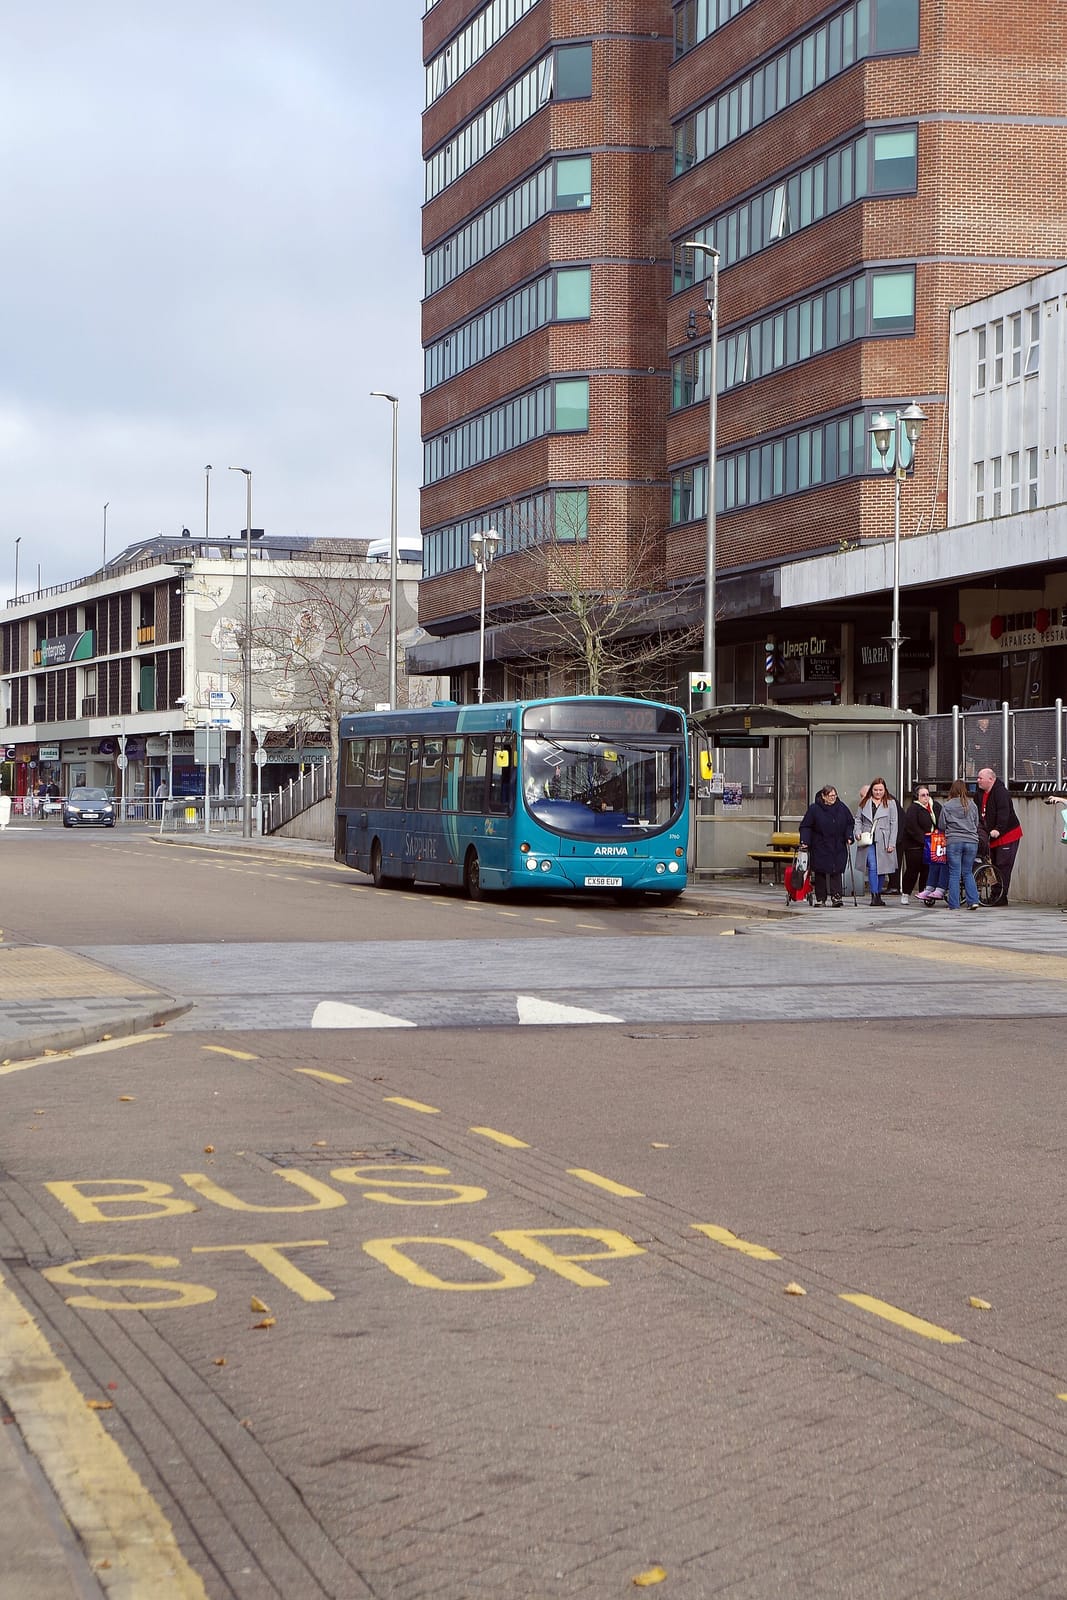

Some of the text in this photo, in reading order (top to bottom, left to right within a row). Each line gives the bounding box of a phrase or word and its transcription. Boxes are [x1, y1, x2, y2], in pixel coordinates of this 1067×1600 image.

[1000, 633, 1036, 648] JAPANESE
[594, 846, 628, 856] ARRIVA
[42, 1165, 488, 1223] BUS
[41, 1228, 649, 1310] STOP
